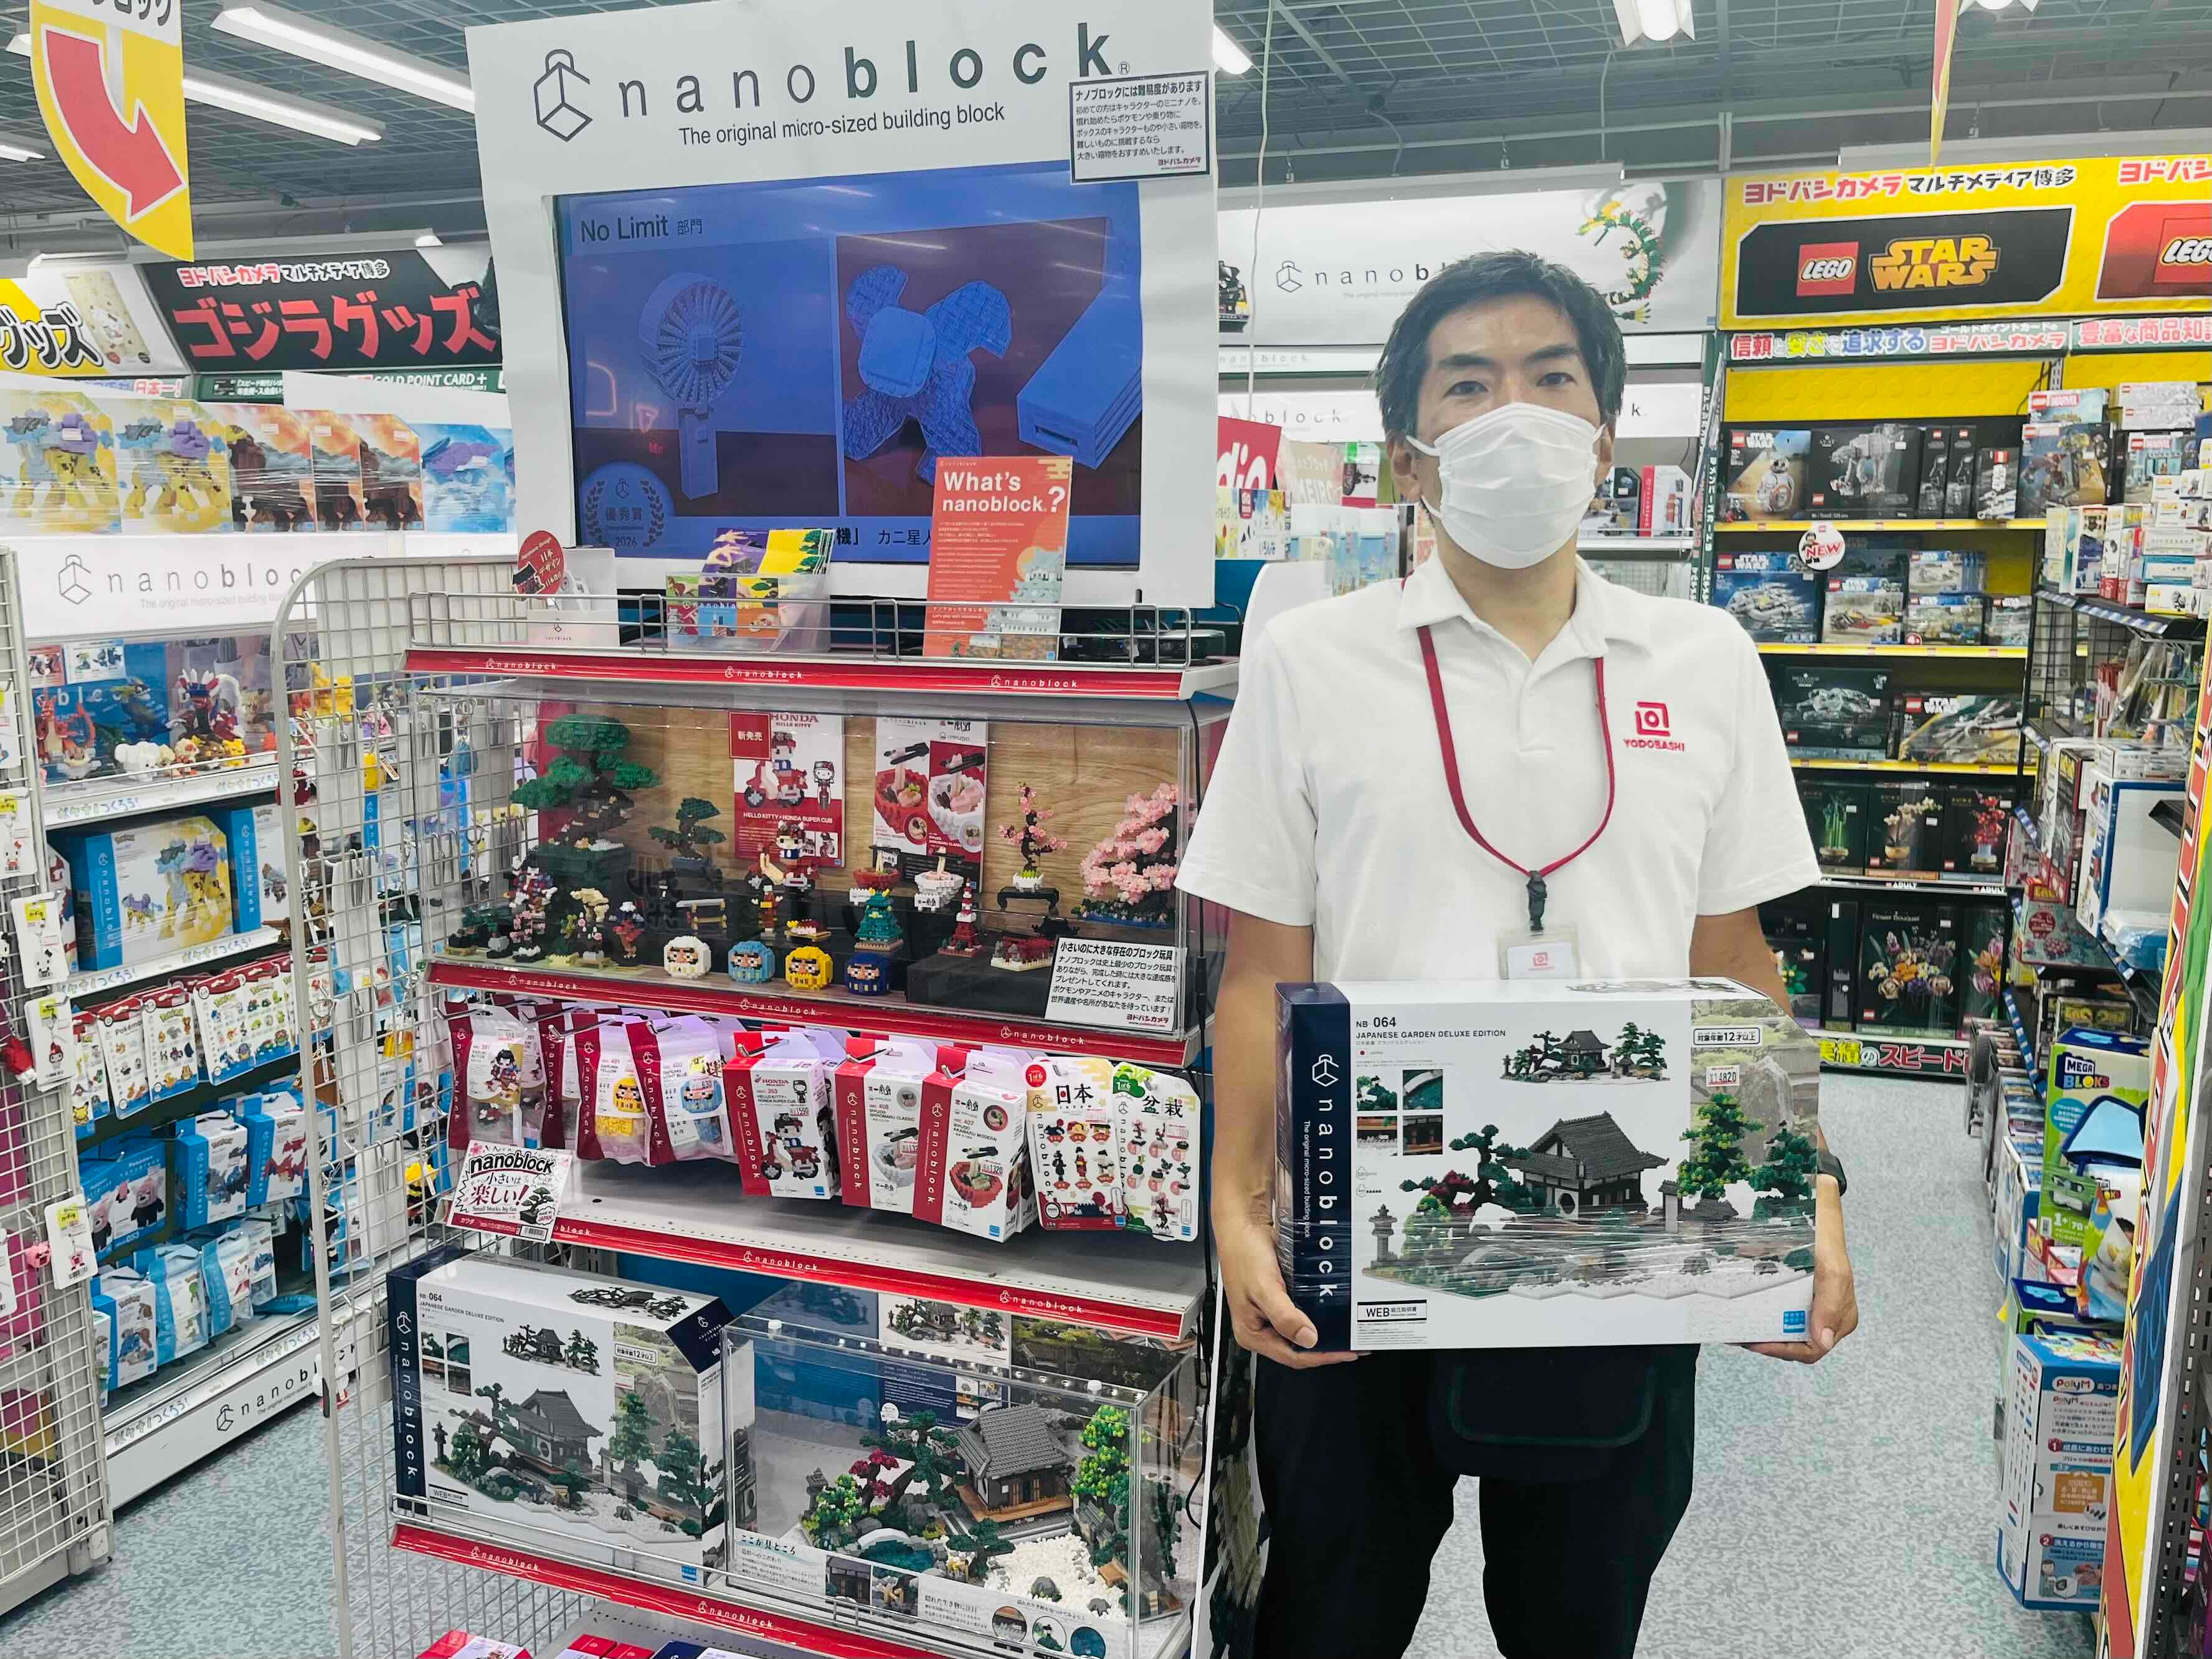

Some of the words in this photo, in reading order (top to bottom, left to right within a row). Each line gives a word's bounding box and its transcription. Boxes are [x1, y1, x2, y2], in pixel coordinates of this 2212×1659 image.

[619, 22, 1113, 118] nanoblock
[1076, 80, 1202, 101] ナノブロックには難易度があります
[679, 126, 711, 146] The
[716, 121, 777, 146] original
[782, 116, 878, 139] micro-sized
[883, 108, 951, 131] building
[957, 102, 1005, 122] block
[1744, 174, 1903, 204] ヨドバシカメラ
[1908, 167, 2074, 194] マルチメディア博多
[580, 220, 610, 244] No
[617, 217, 669, 240] Limit
[677, 219, 703, 236] 部門
[1871, 235, 2001, 266] STAR
[2162, 237, 2212, 264] LEG
[178, 264, 280, 287] ヨドバシカメラ
[1800, 255, 1855, 282] LEGO
[1870, 260, 2000, 292] WARS
[173, 287, 497, 360] ゴジラグッズ
[1929, 332, 2066, 353] ヨドバシカメラ
[444, 373, 476, 386] CARD
[942, 471, 1022, 492] What's
[605, 507, 643, 521] 優秀賞
[942, 495, 1044, 513] nanoblock
[1806, 541, 1843, 558] NEW
[496, 662, 558, 670] nanoblock
[736, 669, 803, 679] nanoblock
[1004, 678, 1078, 688] nanoblock
[737, 730, 764, 741] 新発売
[1624, 739, 1685, 752] YODOBASHI
[518, 980, 578, 990] nanoblock
[751, 1003, 818, 1015] nanoblock
[1126, 1014, 1169, 1024] ヨドバシカメラ
[1373, 1017, 1397, 1028] 064
[1013, 1031, 1085, 1045] nanoblock
[1355, 1031, 1398, 1039] JAPANESE
[2066, 1059, 2094, 1074] MEGA
[2063, 1075, 2110, 1089] BLOKS
[1055, 1083, 1094, 1105] 日本
[1141, 1095, 1184, 1118] 盆栽
[740, 1103, 761, 1178] nanoblock
[849, 1109, 863, 1189] nanoblock
[1303, 1134, 1311, 1157] original
[470, 1150, 556, 1174] nanoblock
[927, 1121, 940, 1204] nanoblock
[1037, 1113, 1053, 1197] nanoblock
[1303, 1196, 1311, 1220] building
[1318, 1098, 1337, 1297] nanoblock
[754, 1255, 819, 1271] nanoblock
[429, 1293, 442, 1302] 064
[1012, 1295, 1083, 1314] nanoblock
[419, 1301, 444, 1310] JAPANESE
[444, 1306, 465, 1315] GARDEN
[465, 1310, 484, 1319] DELUXE
[485, 1314, 505, 1323] EDITION
[1365, 1307, 1390, 1318] WEB
[2056, 1378, 2091, 1390] PolyM
[400, 1341, 417, 1478] nanoblock
[480, 1550, 539, 1572] nanoblock
[710, 1605, 774, 1629] nanoblock
